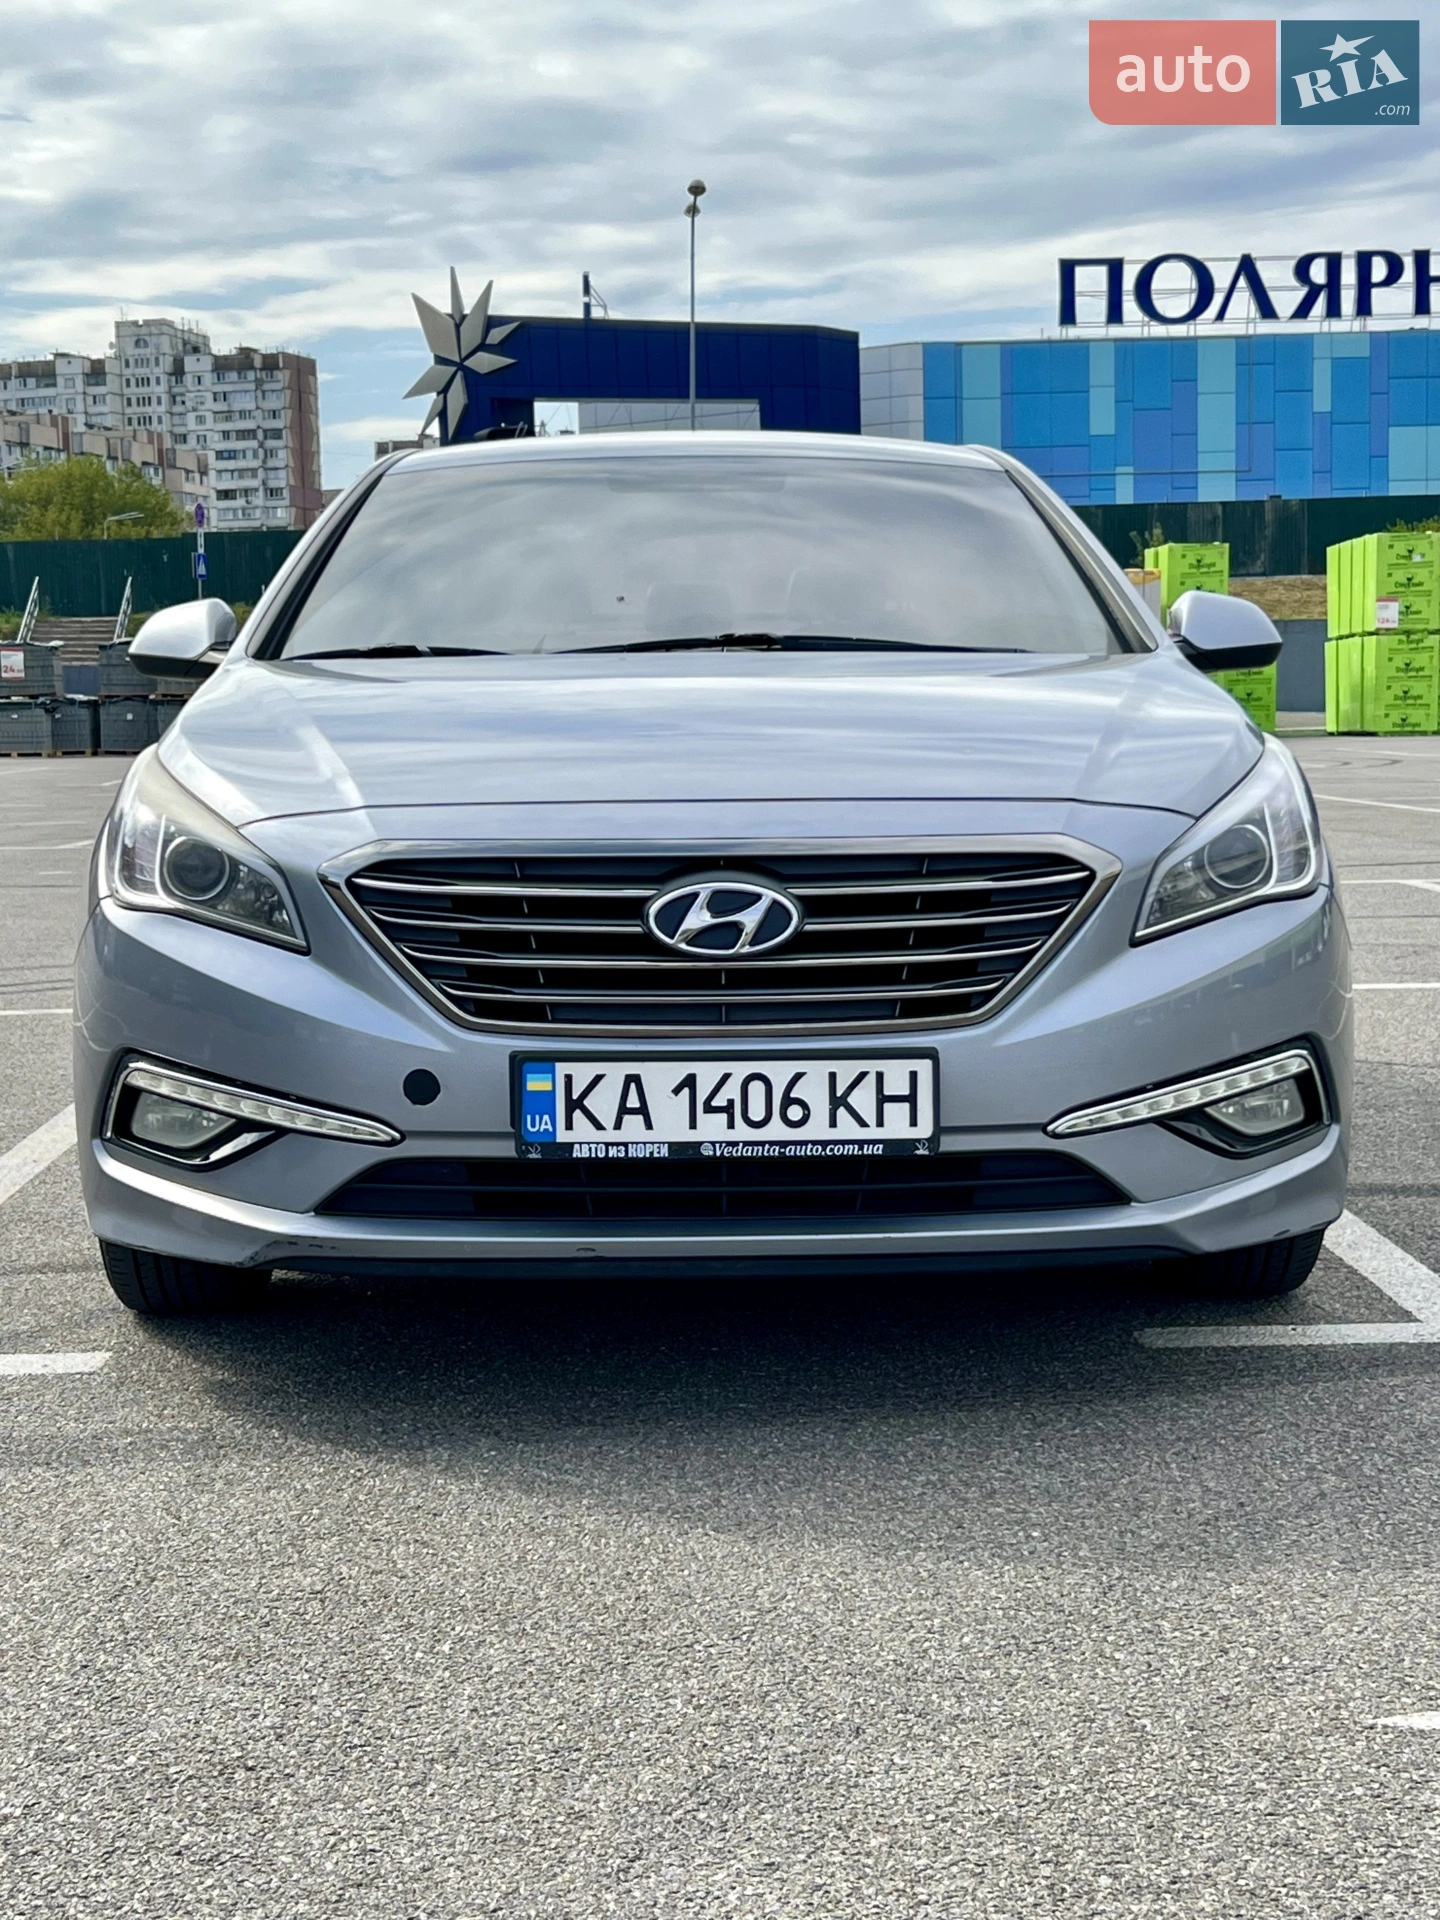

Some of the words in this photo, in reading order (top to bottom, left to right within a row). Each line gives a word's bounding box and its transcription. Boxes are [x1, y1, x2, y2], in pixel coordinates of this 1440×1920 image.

[564, 1073, 654, 1131] KA
[671, 1072, 811, 1130] 1406
[828, 1070, 918, 1129] KH
[526, 1114, 553, 1132] UA
[572, 1143, 606, 1158] АВТО
[608, 1145, 626, 1158] из
